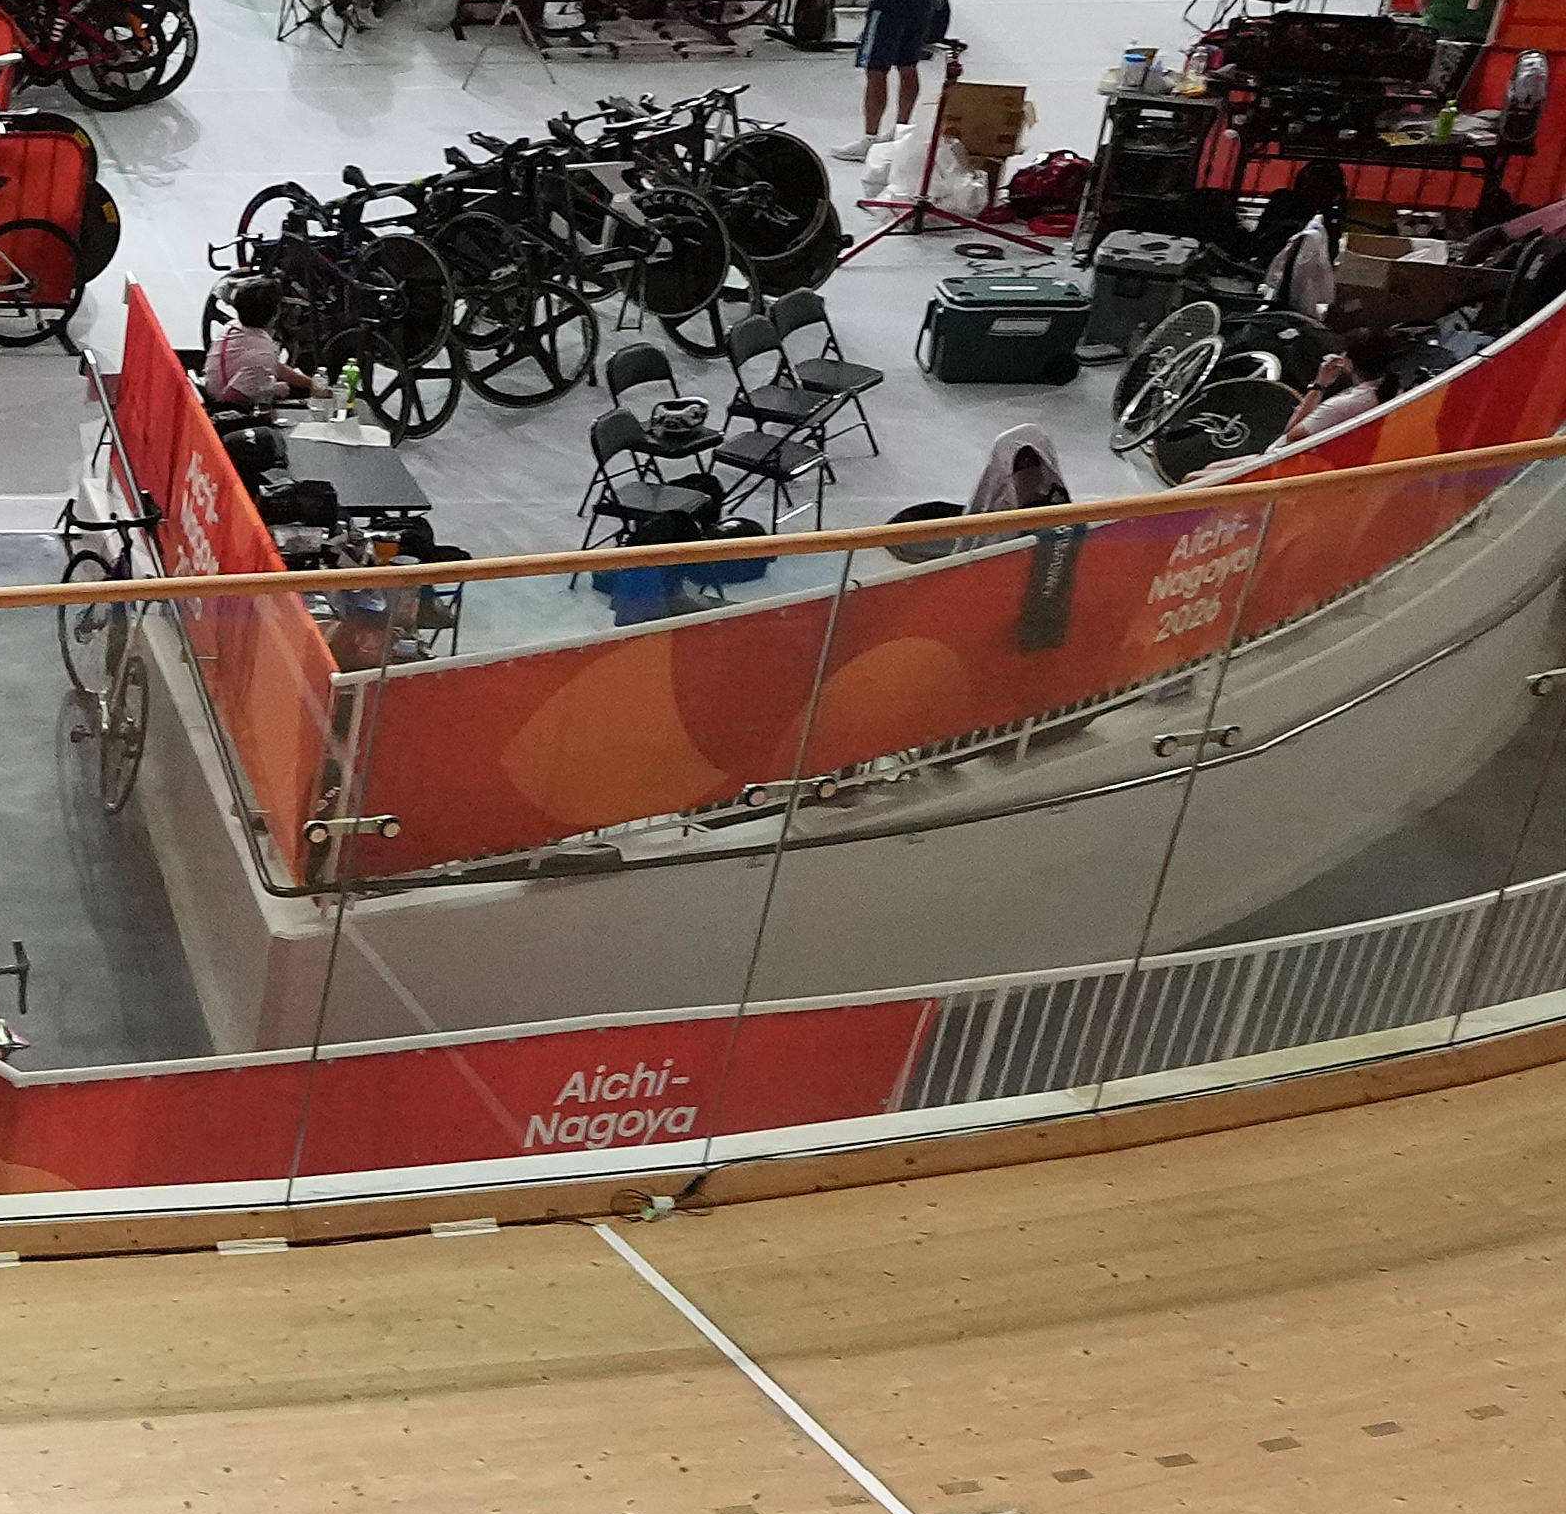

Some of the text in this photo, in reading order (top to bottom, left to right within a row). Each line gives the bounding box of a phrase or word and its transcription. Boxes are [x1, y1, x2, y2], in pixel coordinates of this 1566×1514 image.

[1167, 513, 1251, 567] Aichi-
[1147, 546, 1255, 605] Nagoya
[1154, 593, 1223, 643] 2026
[553, 1059, 690, 1106] Aichi-
[523, 1103, 699, 1150] Nagoya
